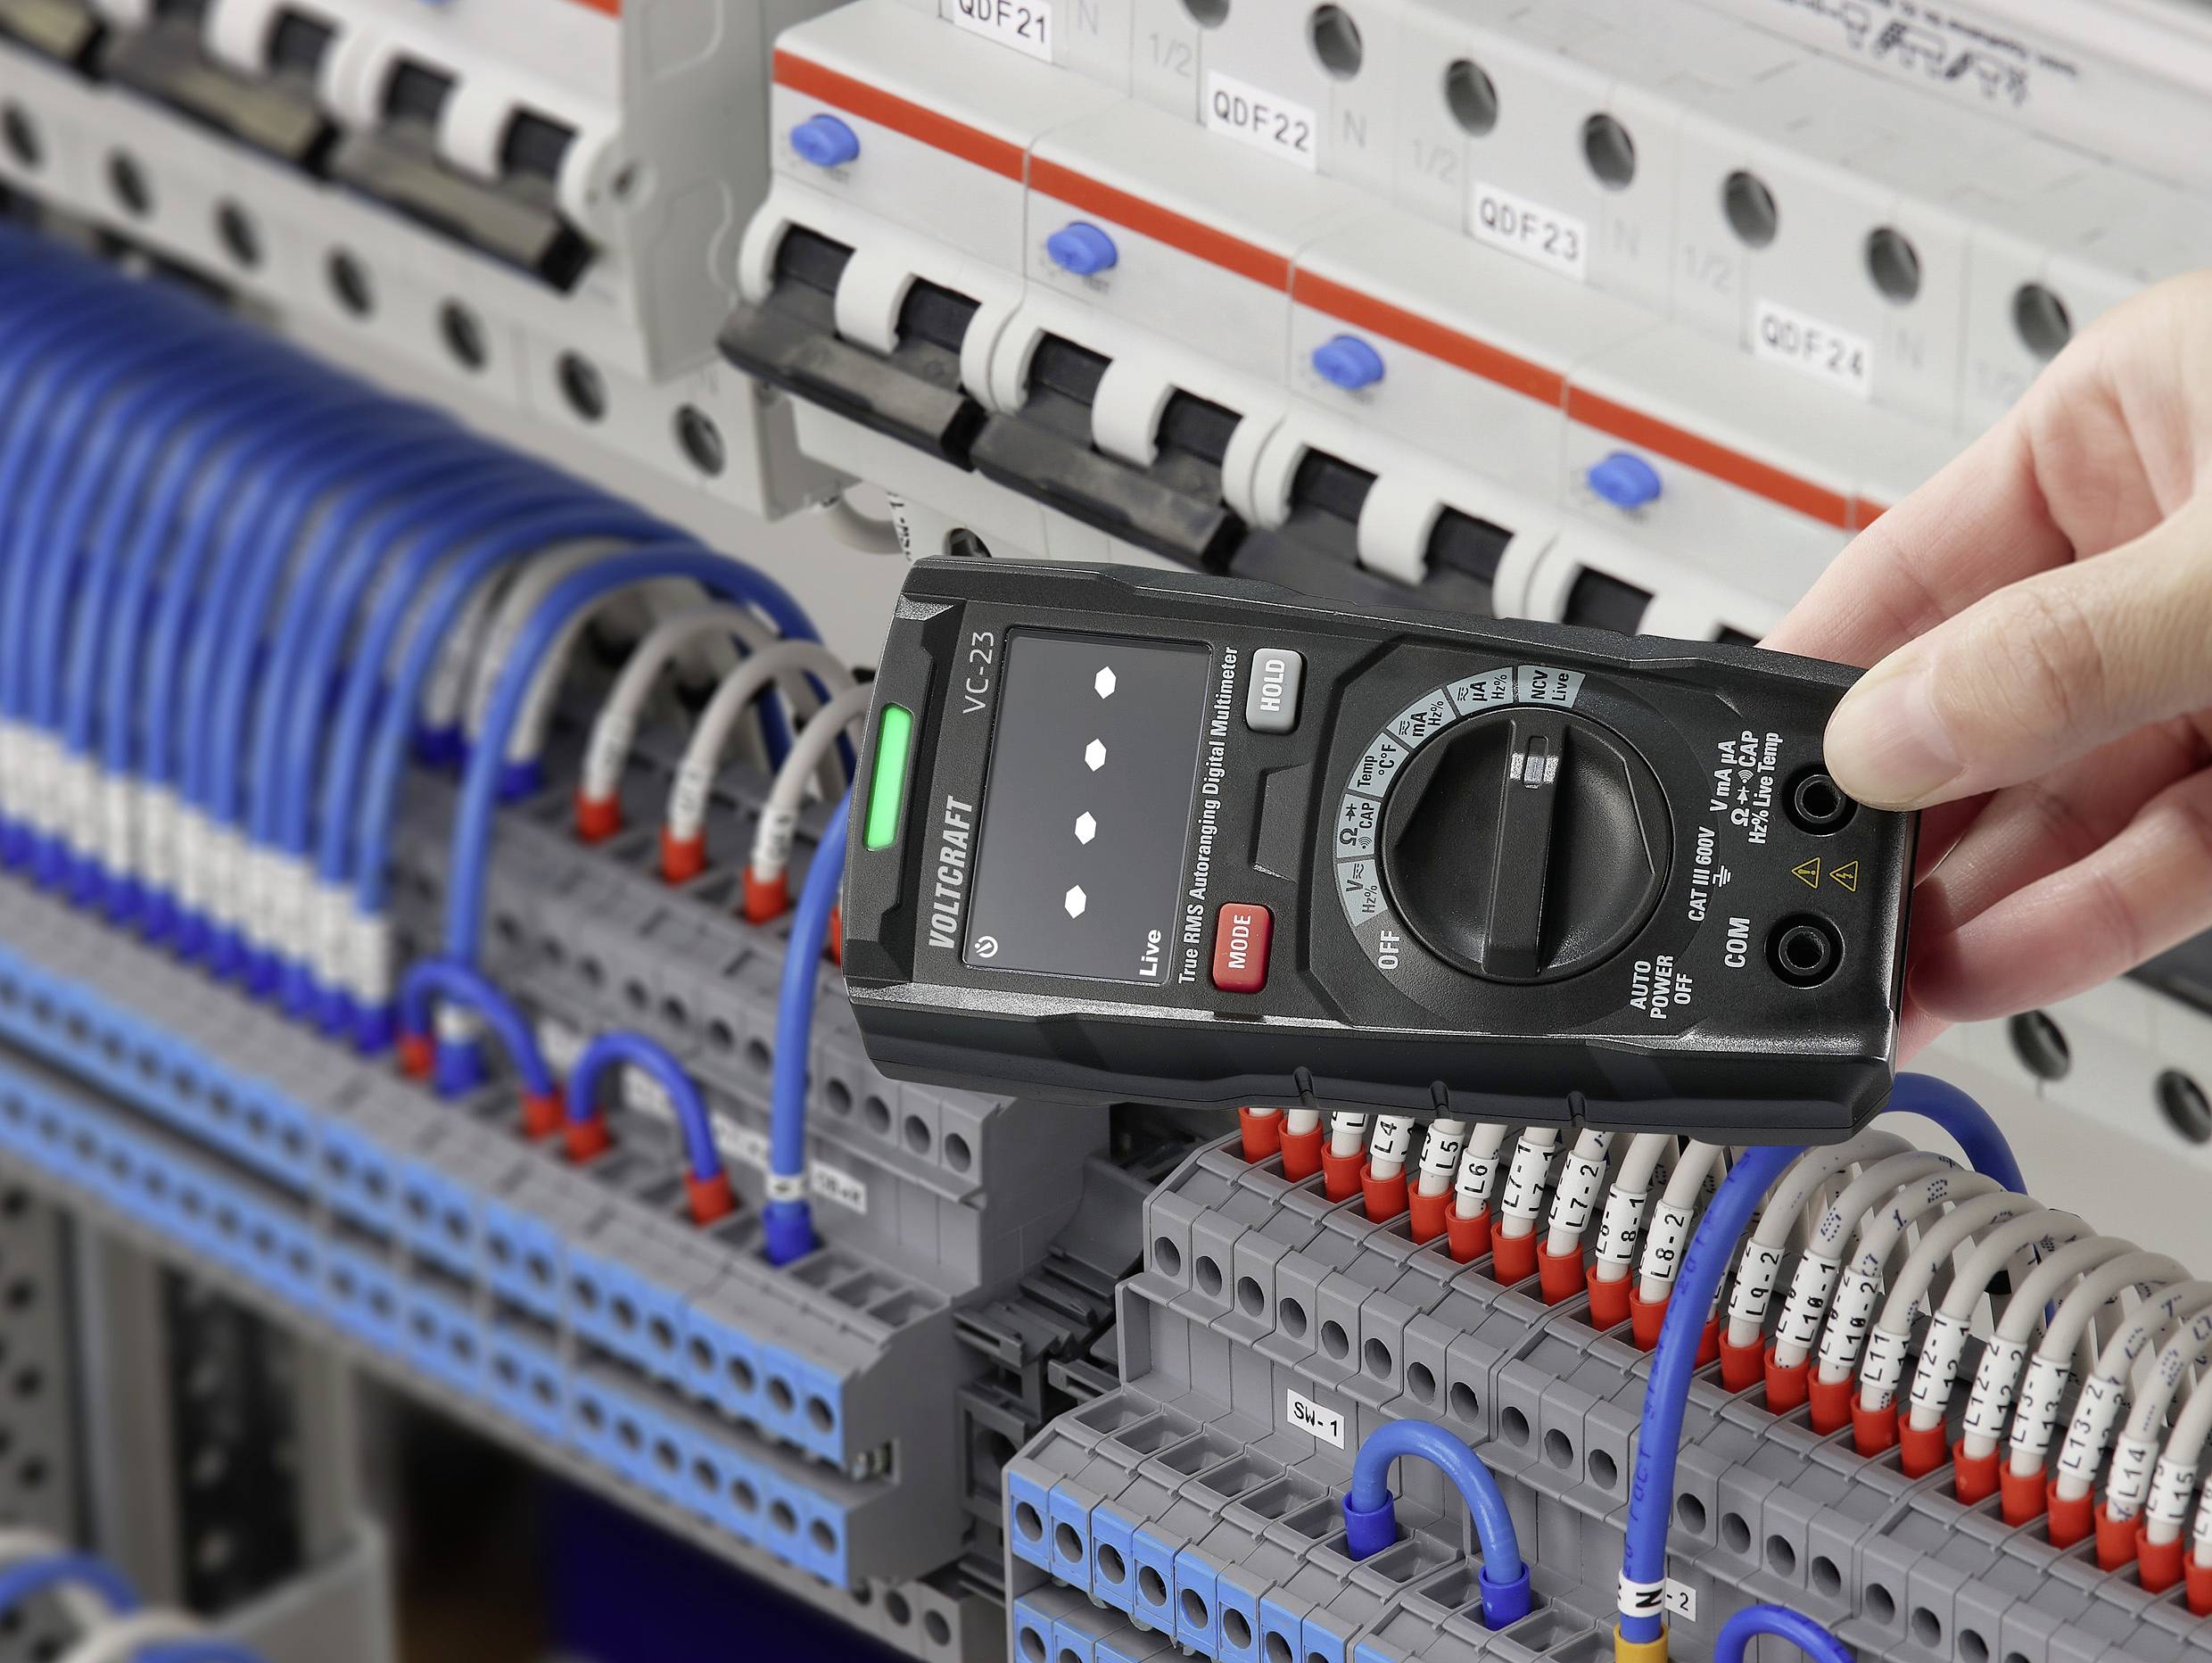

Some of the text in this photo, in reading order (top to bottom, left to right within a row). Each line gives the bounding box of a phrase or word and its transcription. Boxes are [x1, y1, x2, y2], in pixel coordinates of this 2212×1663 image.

[959, 0, 1045, 44] QDF21
[1212, 90, 1310, 153] QDF22
[1342, 109, 1368, 149] N
[1479, 195, 1580, 262] QDF23
[1761, 313, 1865, 379] QDF24
[962, 631, 995, 714] VC-23
[1259, 658, 1285, 712] HOLD
[1490, 673, 1507, 701] Hz%
[1531, 669, 1548, 700] NCV
[1551, 672, 1570, 702] Live
[1411, 711, 1427, 739] mA
[1427, 699, 1444, 727] Hz%
[1357, 755, 1376, 788] Temp
[1738, 730, 1759, 767] CAP
[1710, 798, 1728, 812] V
[1713, 768, 1732, 797] mA
[1748, 732, 1784, 844] Hz% Live Temp
[1178, 646, 1239, 984] True RMS Autoranging Digital Multimeter
[1358, 802, 1374, 829] CAP
[929, 795, 972, 949] VOLTCRAFT
[1688, 826, 1715, 922] CAT III 600V
[1362, 883, 1377, 914] Hz%
[1138, 929, 1162, 977] Live
[1228, 914, 1251, 970] MODE
[1378, 930, 1400, 970] OFF
[1724, 916, 1750, 968] COM
[1630, 960, 1651, 1010] AUTO
[1650, 955, 1674, 1019] POWER
[1673, 973, 1693, 1005] OFF
[1374, 1121, 1398, 1154] L4
[1435, 1140, 1458, 1170] L5
[1464, 1162, 1488, 1194] L6
[1503, 1145, 1531, 1209] L7-1
[1565, 1164, 1599, 1228] L7-2
[1616, 1198, 1645, 1259] L8-1
[1650, 1213, 1685, 1278] L8-2
[1746, 1252, 1779, 1316] L9-2
[1795, 1262, 1836, 1343] L10-1
[1839, 1282, 1878, 1363] L10-2
[1864, 1333, 1891, 1383] L11
[1911, 1318, 1947, 1401] L12-1
[1965, 1340, 2001, 1427] L12-2
[1293, 1402, 1339, 1437] SW-1
[2061, 1384, 2103, 1469] L13-2
[2118, 1449, 2146, 1499] L14
[2168, 1472, 2193, 1518] L15
